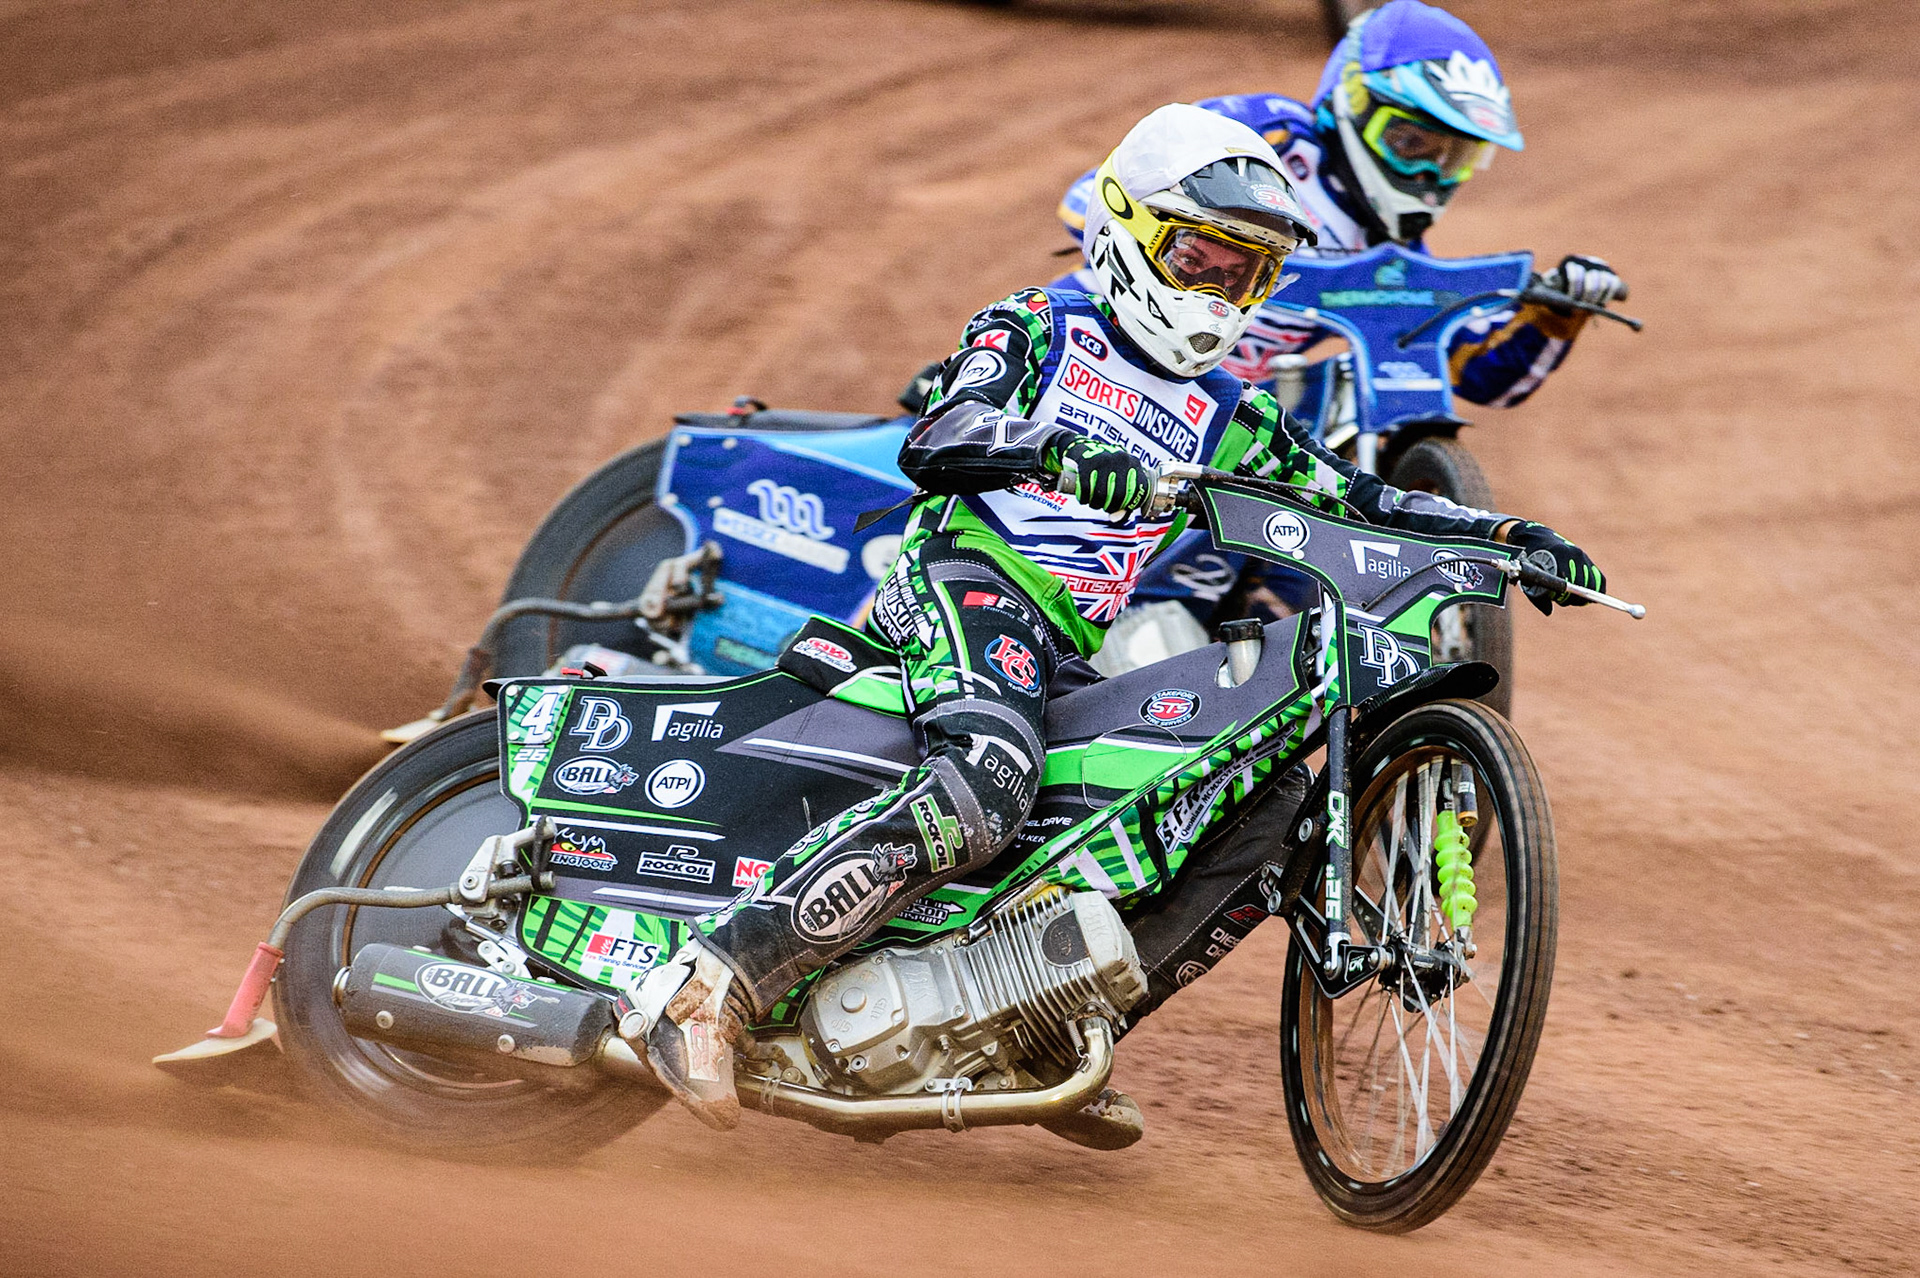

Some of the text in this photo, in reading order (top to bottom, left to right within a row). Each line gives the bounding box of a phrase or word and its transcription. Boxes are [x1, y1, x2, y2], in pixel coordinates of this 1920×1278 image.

[1209, 302, 1229, 315] STS
[1079, 333, 1103, 356] SCB
[1064, 363, 1197, 460] SPORTS INSURE
[1184, 393, 1208, 426] 9
[1059, 402, 1130, 447] BRITISH
[1022, 492, 1063, 513] SPEEDWAY
[1272, 525, 1300, 537] ATPI
[1367, 558, 1412, 579] agilia
[520, 693, 560, 736] 4
[1150, 701, 1191, 714] STS
[668, 719, 725, 742] agilia
[513, 748, 551, 762] 26
[656, 776, 692, 790] ATPI
[1041, 816, 1073, 827] DAVE
[917, 801, 948, 869] ROCK OIL
[642, 860, 710, 876] ROCK OIL
[598, 956, 621, 966] Training
[609, 938, 658, 963] FTS
